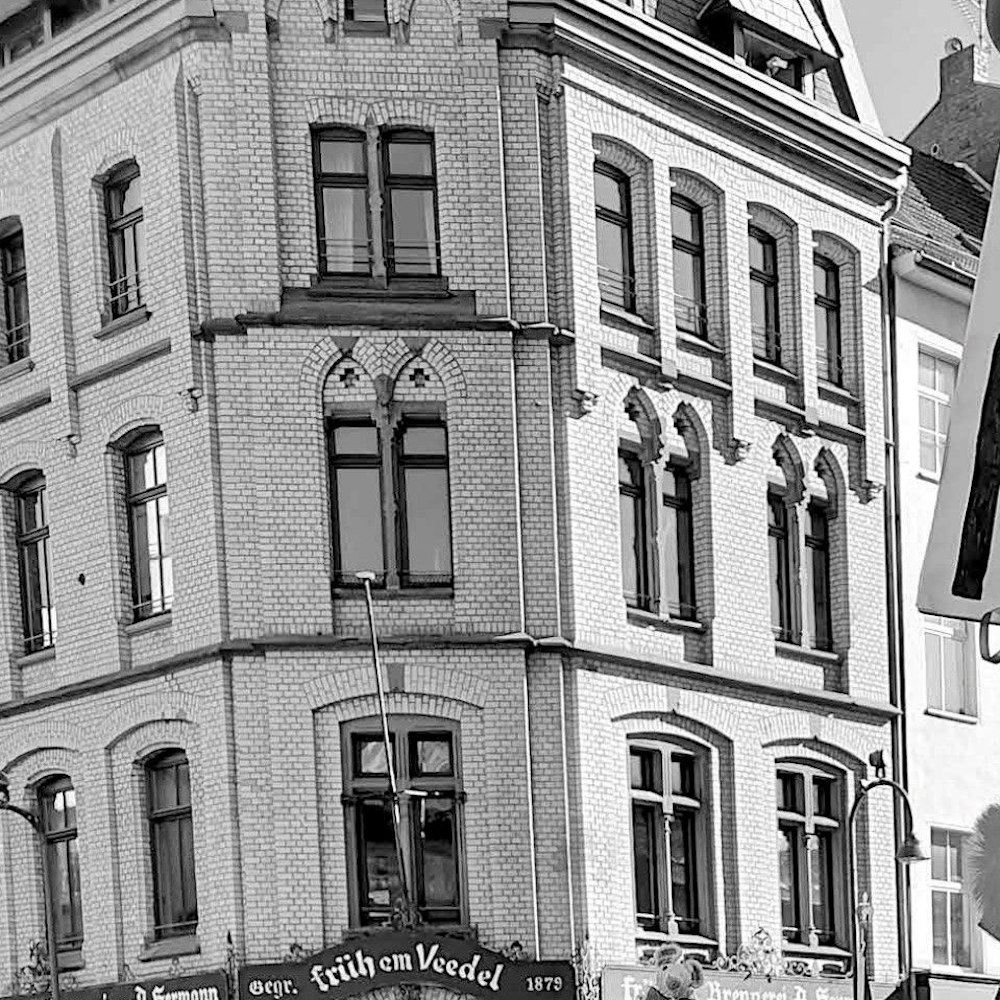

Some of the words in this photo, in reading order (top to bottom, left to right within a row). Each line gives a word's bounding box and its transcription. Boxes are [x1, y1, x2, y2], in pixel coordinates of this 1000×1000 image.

[249, 978, 299, 999] Gegr.
[378, 951, 413, 972] em
[415, 942, 504, 991] Veedel
[526, 976, 563, 992] 1879
